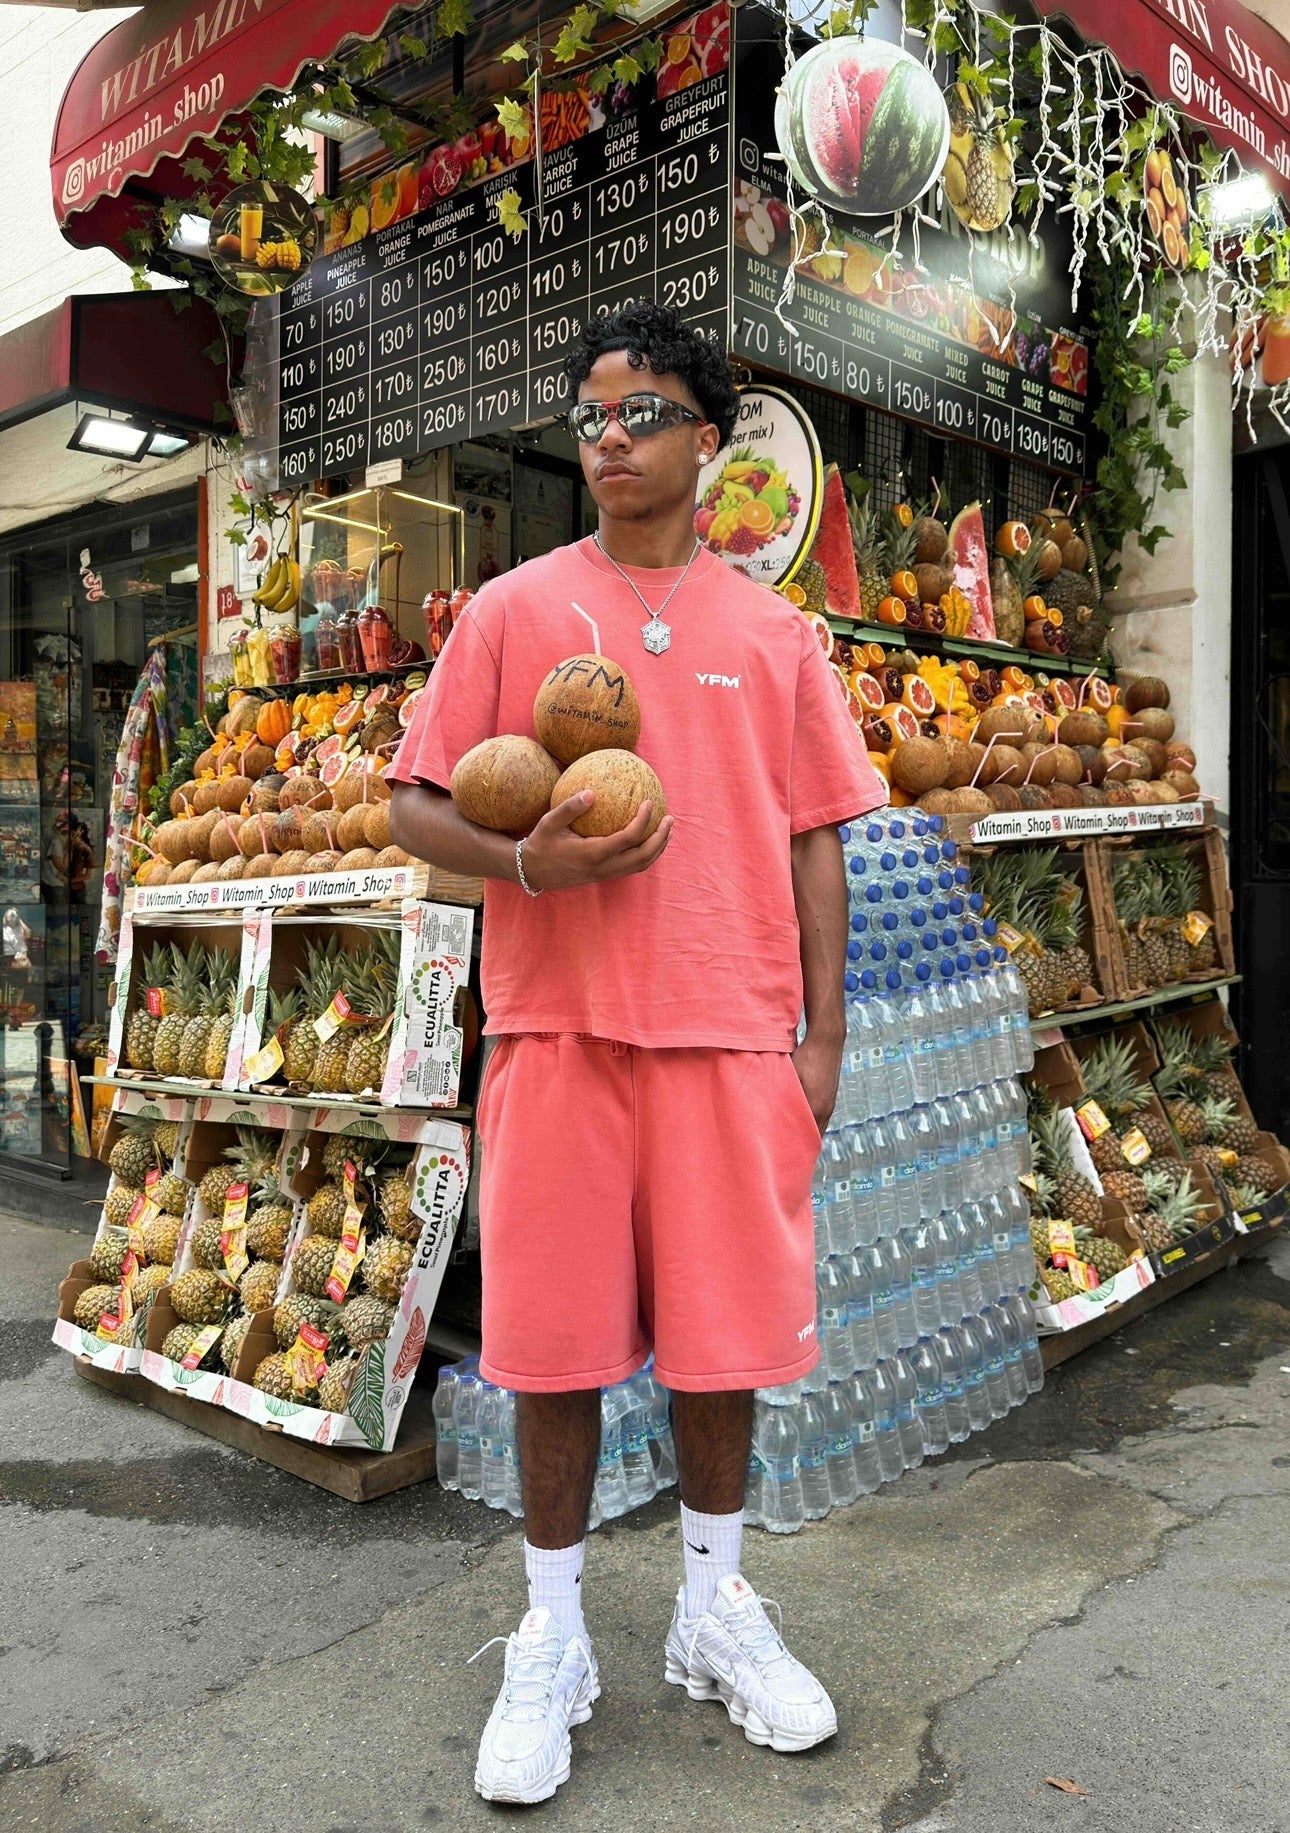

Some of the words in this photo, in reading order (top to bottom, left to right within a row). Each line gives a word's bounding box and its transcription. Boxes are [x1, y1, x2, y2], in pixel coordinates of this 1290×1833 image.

[665, 74, 725, 113] GREYFURT
[660, 91, 727, 132] GRAPEFRUIT
[85, 73, 225, 183] witamin_shop
[606, 115, 637, 140] ÜZÜM
[677, 118, 709, 143] JUICE
[604, 131, 640, 157] GRAPE
[606, 147, 638, 172] JUICE
[544, 175, 573, 199] JUICE
[751, 175, 772, 193] ELMA
[436, 200, 454, 217] NAR
[376, 218, 416, 245] PORTAKAL
[417, 203, 475, 239] POMEGRANATE
[378, 234, 411, 257] ORANGE
[432, 227, 458, 248] JUICE
[332, 242, 363, 265] ANANAS
[383, 249, 406, 268] JUICE
[327, 255, 366, 281] PINEAPPLE
[747, 258, 778, 283] APPLE
[291, 278, 313, 297] APPLE
[335, 271, 357, 290] JUICE
[748, 279, 776, 304] JUICE
[292, 292, 312, 309] JUICE
[803, 305, 829, 328] JUICE
[845, 303, 882, 328] ORANGE
[851, 323, 876, 345] JUICE
[886, 319, 940, 353] POMEGRANATE
[903, 344, 924, 363] JUICE
[944, 346, 969, 367] MIXED
[945, 364, 967, 384] JUICE
[982, 361, 1010, 384] CARROT
[986, 381, 1006, 400] JUICE
[1021, 378, 1044, 397] GRAPE
[1023, 396, 1042, 413] JUICE
[1048, 390, 1085, 414] GRAPEFRUIT
[1058, 409, 1075, 426] JUICE
[548, 659, 624, 708] YFM
[978, 817, 1051, 838] Witamin_Shop
[1064, 813, 1128, 832] Witamin_Shop
[145, 890, 209, 908] Witamin_Shop
[222, 884, 295, 904] Witamin_Shop
[308, 875, 392, 897] Witamin_Shop
[424, 971, 441, 1048] ECUALITTA
[418, 1170, 450, 1269] ECUALITTA
